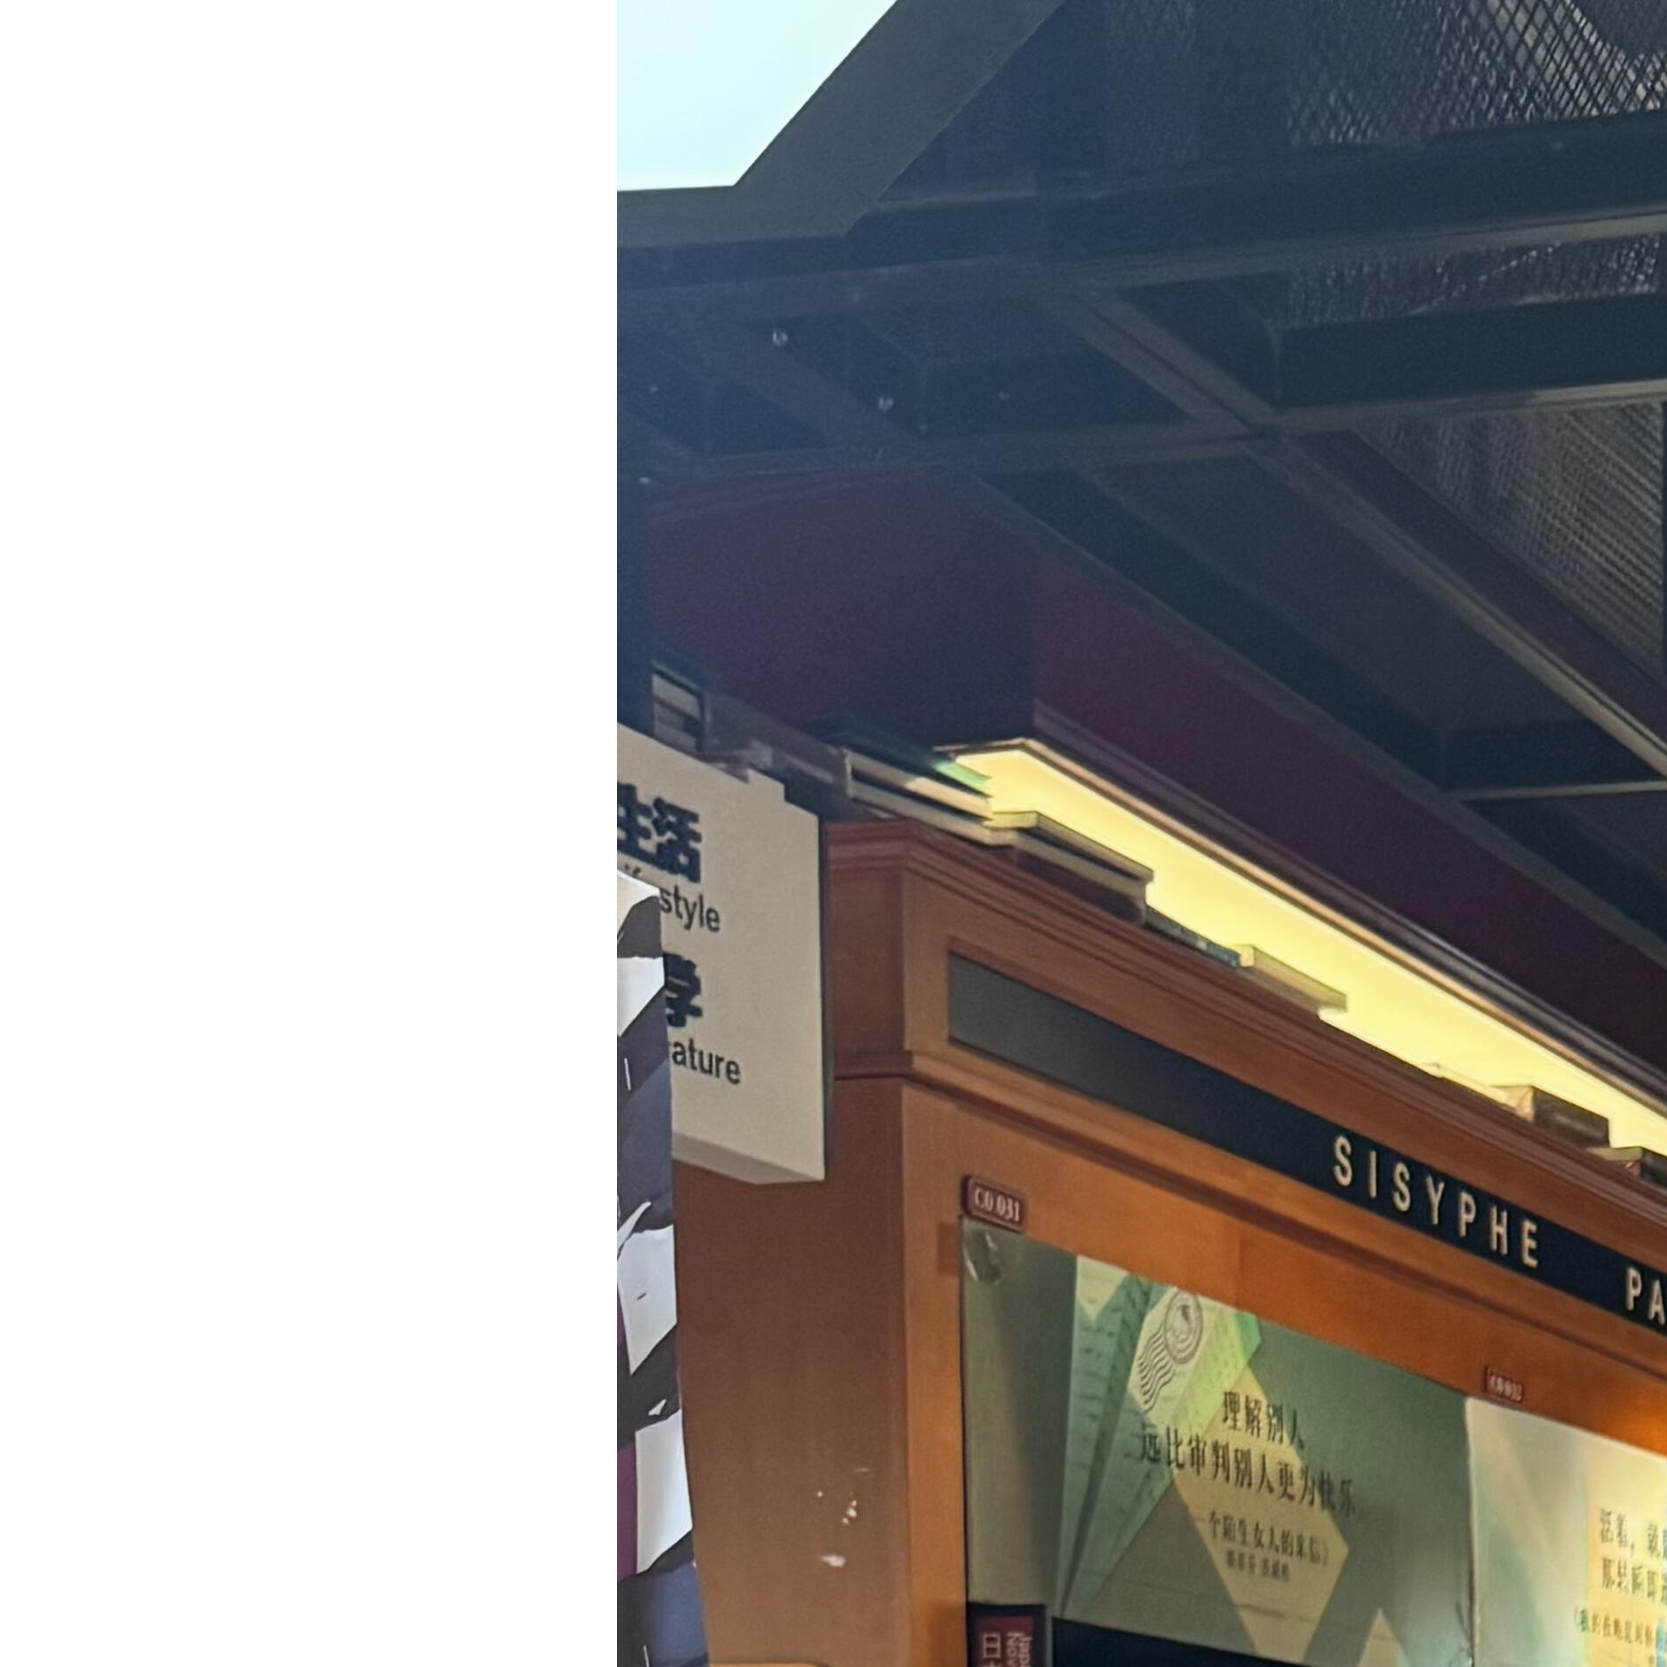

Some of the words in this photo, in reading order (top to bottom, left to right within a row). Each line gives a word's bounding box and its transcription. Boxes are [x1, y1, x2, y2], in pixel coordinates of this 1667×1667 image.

[1332, 1134, 1541, 1269] SISYPHE
[1221, 1390, 1305, 1452] 理解别人
